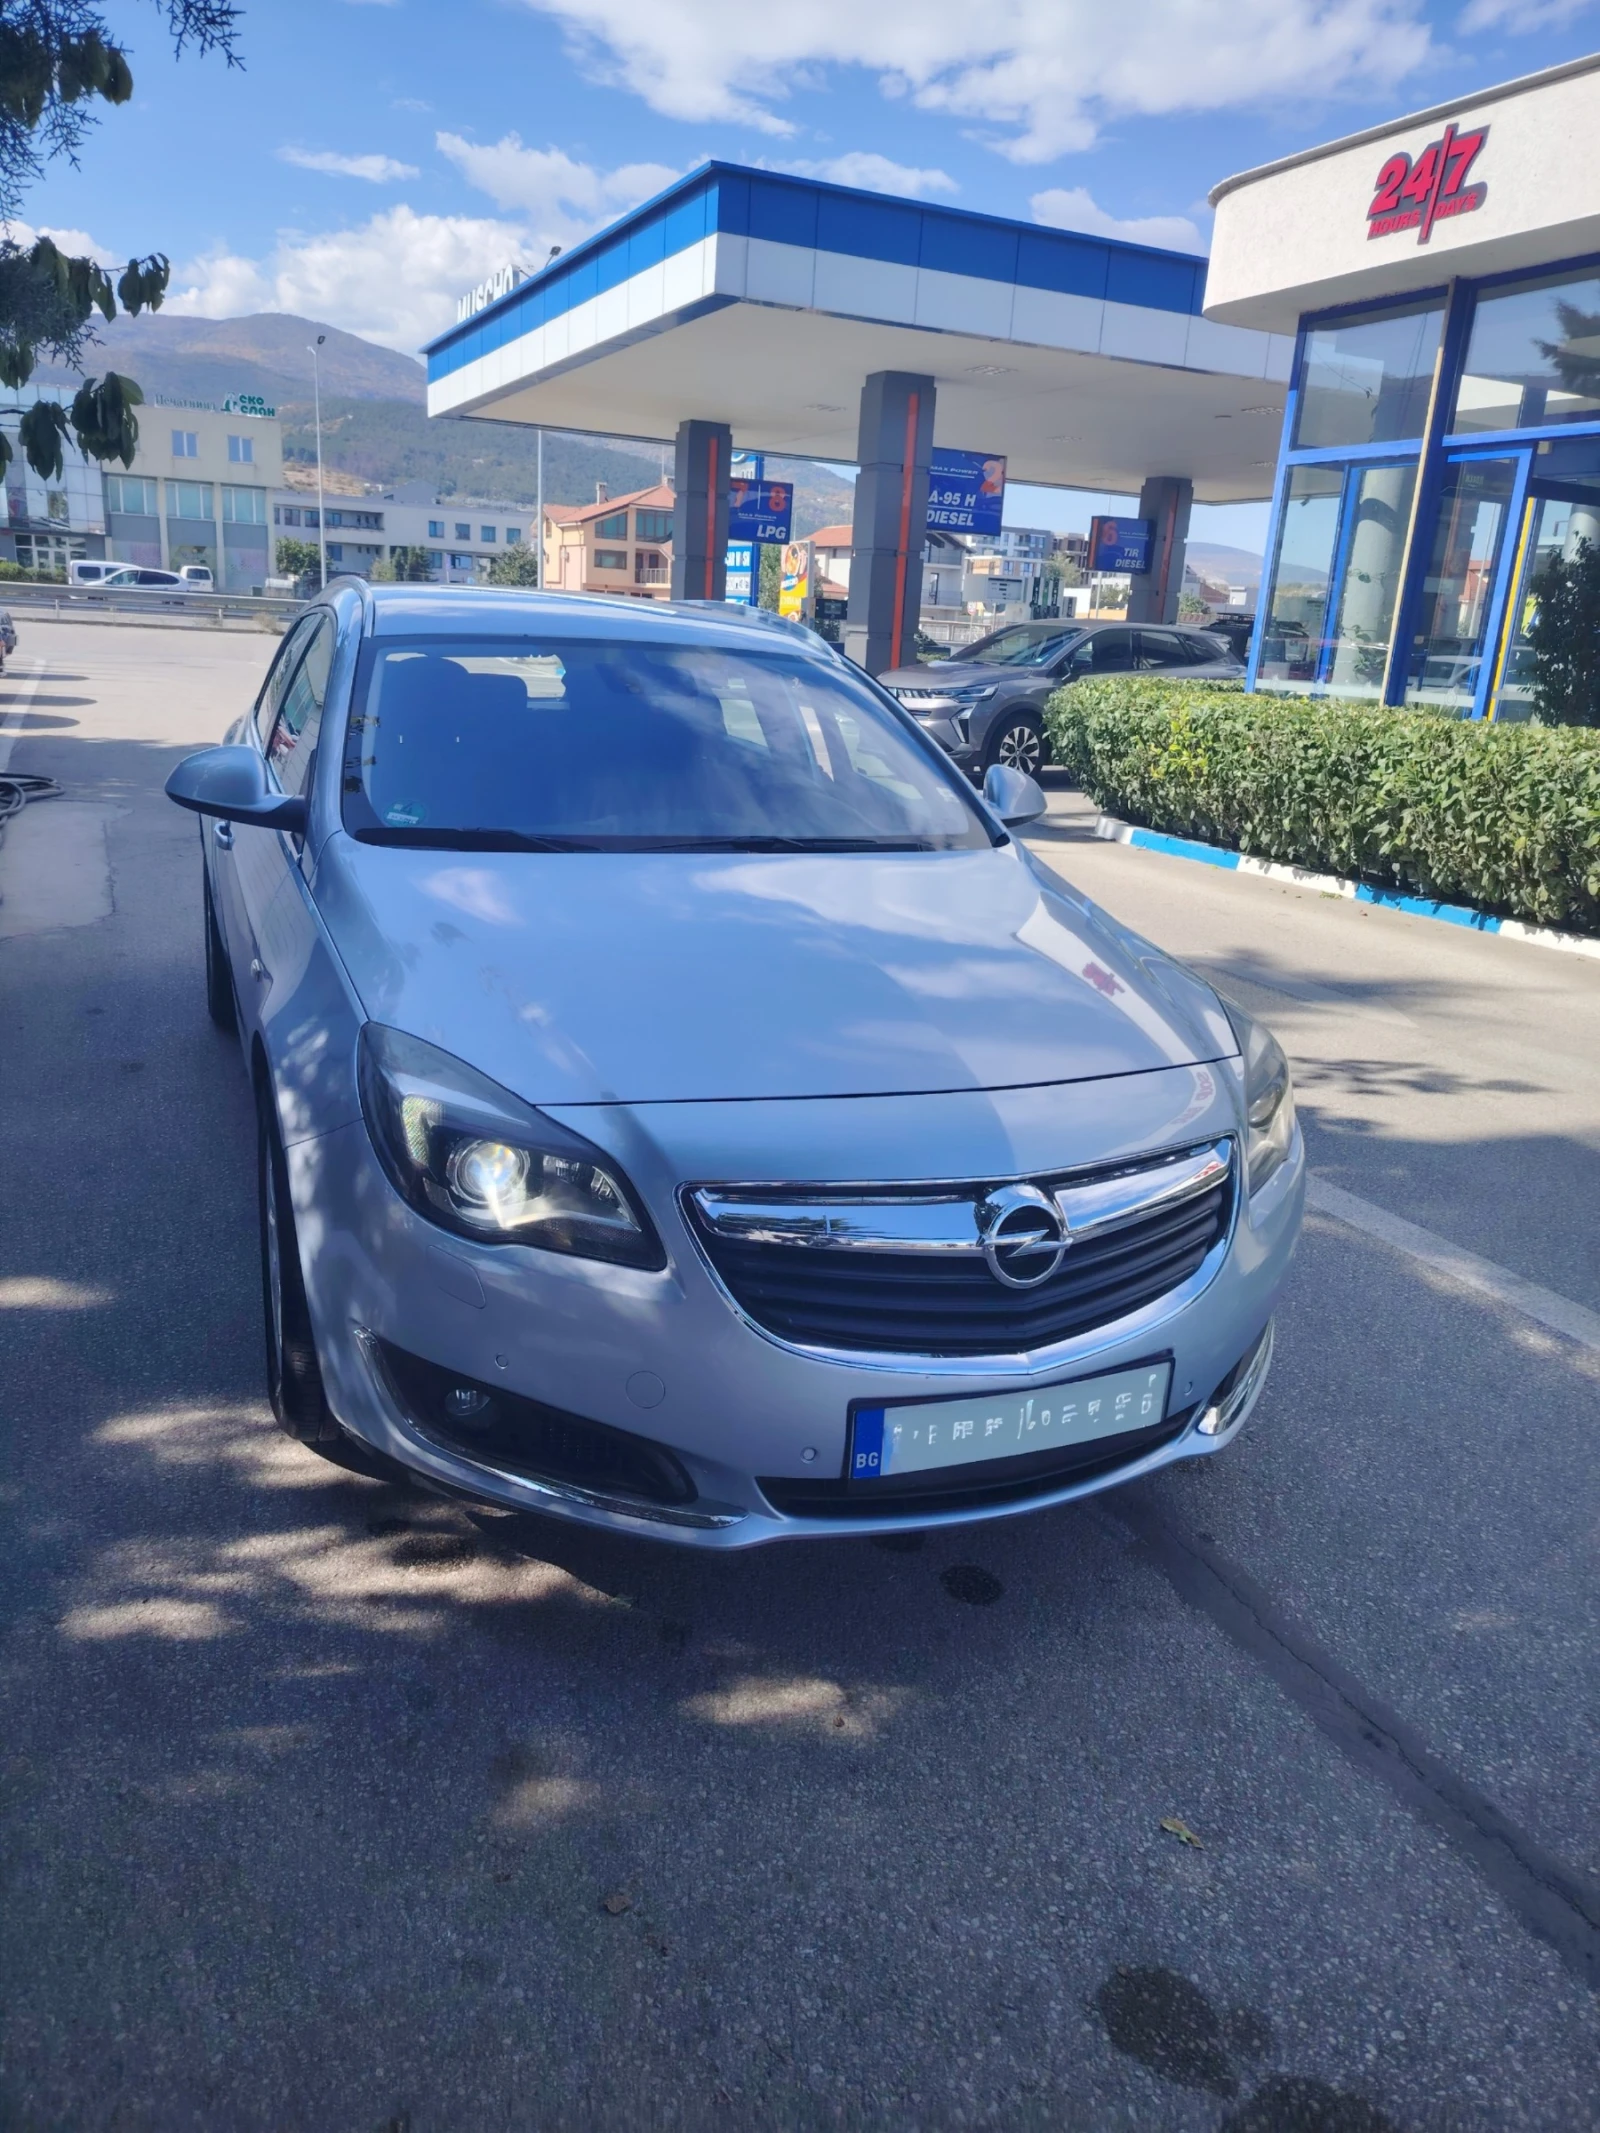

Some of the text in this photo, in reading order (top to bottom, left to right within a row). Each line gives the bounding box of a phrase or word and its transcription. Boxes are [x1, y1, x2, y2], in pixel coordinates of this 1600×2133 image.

[1369, 209, 1421, 237] HOURS
[981, 460, 1003, 493] 2
[731, 482, 786, 512] 7 8
[928, 490, 976, 507] A-95 H
[926, 510, 974, 526] DIESEL
[756, 525, 787, 540] LPG
[1102, 521, 1118, 545] 6
[1124, 548, 1139, 557] TIR
[1115, 559, 1146, 569] DIESEL
[856, 1452, 878, 1468] BG
